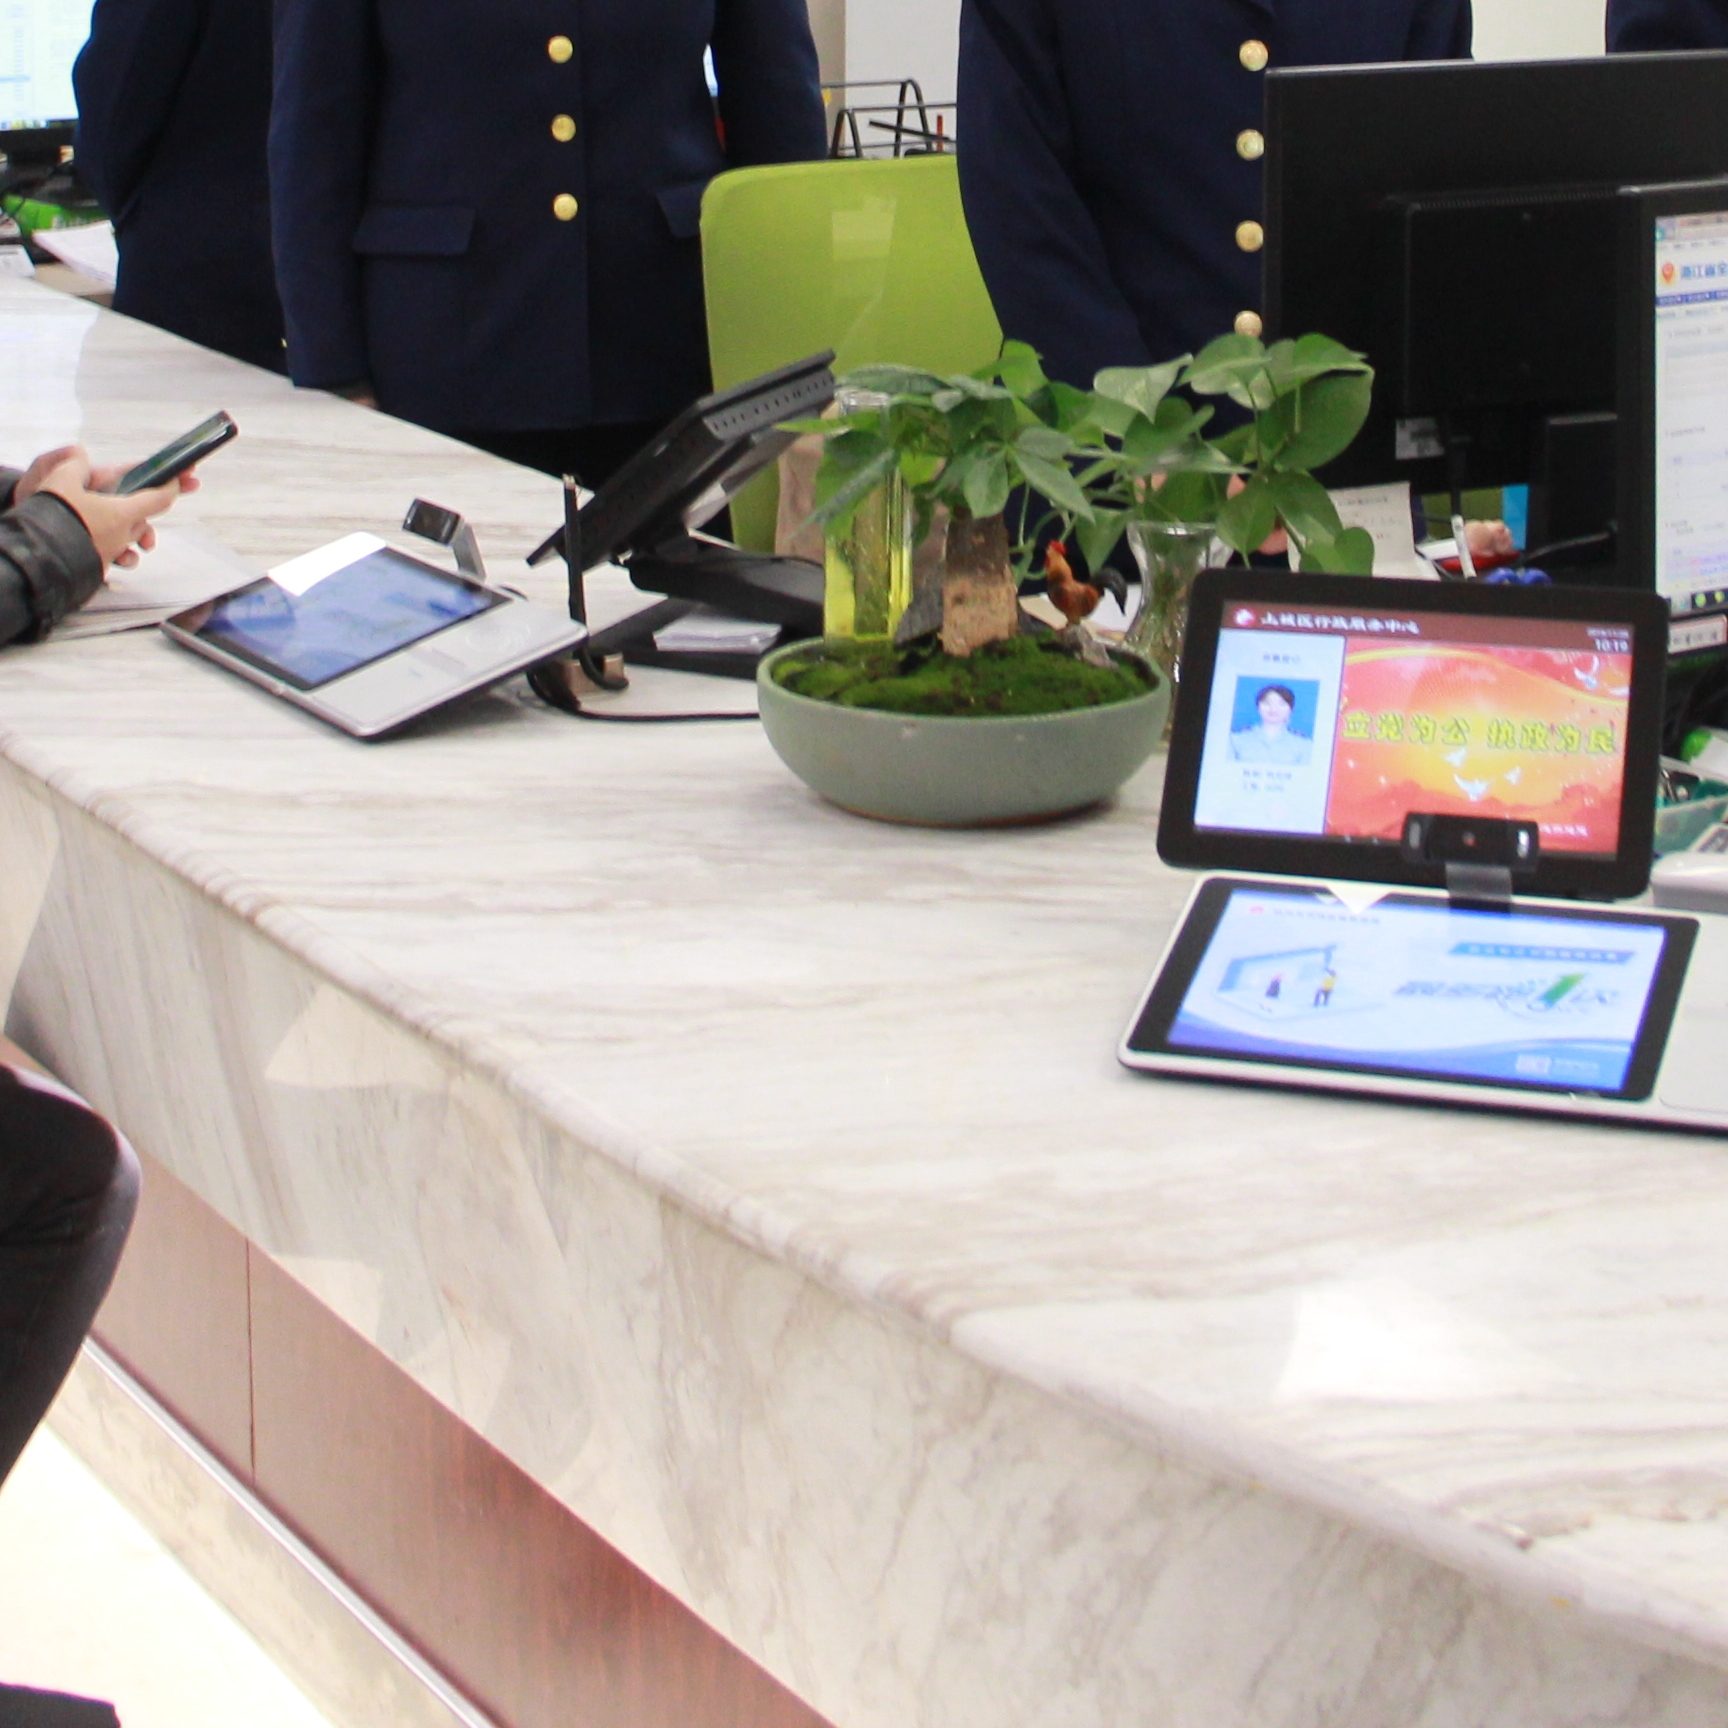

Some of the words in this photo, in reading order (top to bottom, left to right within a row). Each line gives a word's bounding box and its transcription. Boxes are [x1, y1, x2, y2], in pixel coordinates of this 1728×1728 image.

[1341, 710, 1471, 746] 立党为公
[1486, 718, 1616, 755] 执政为民
